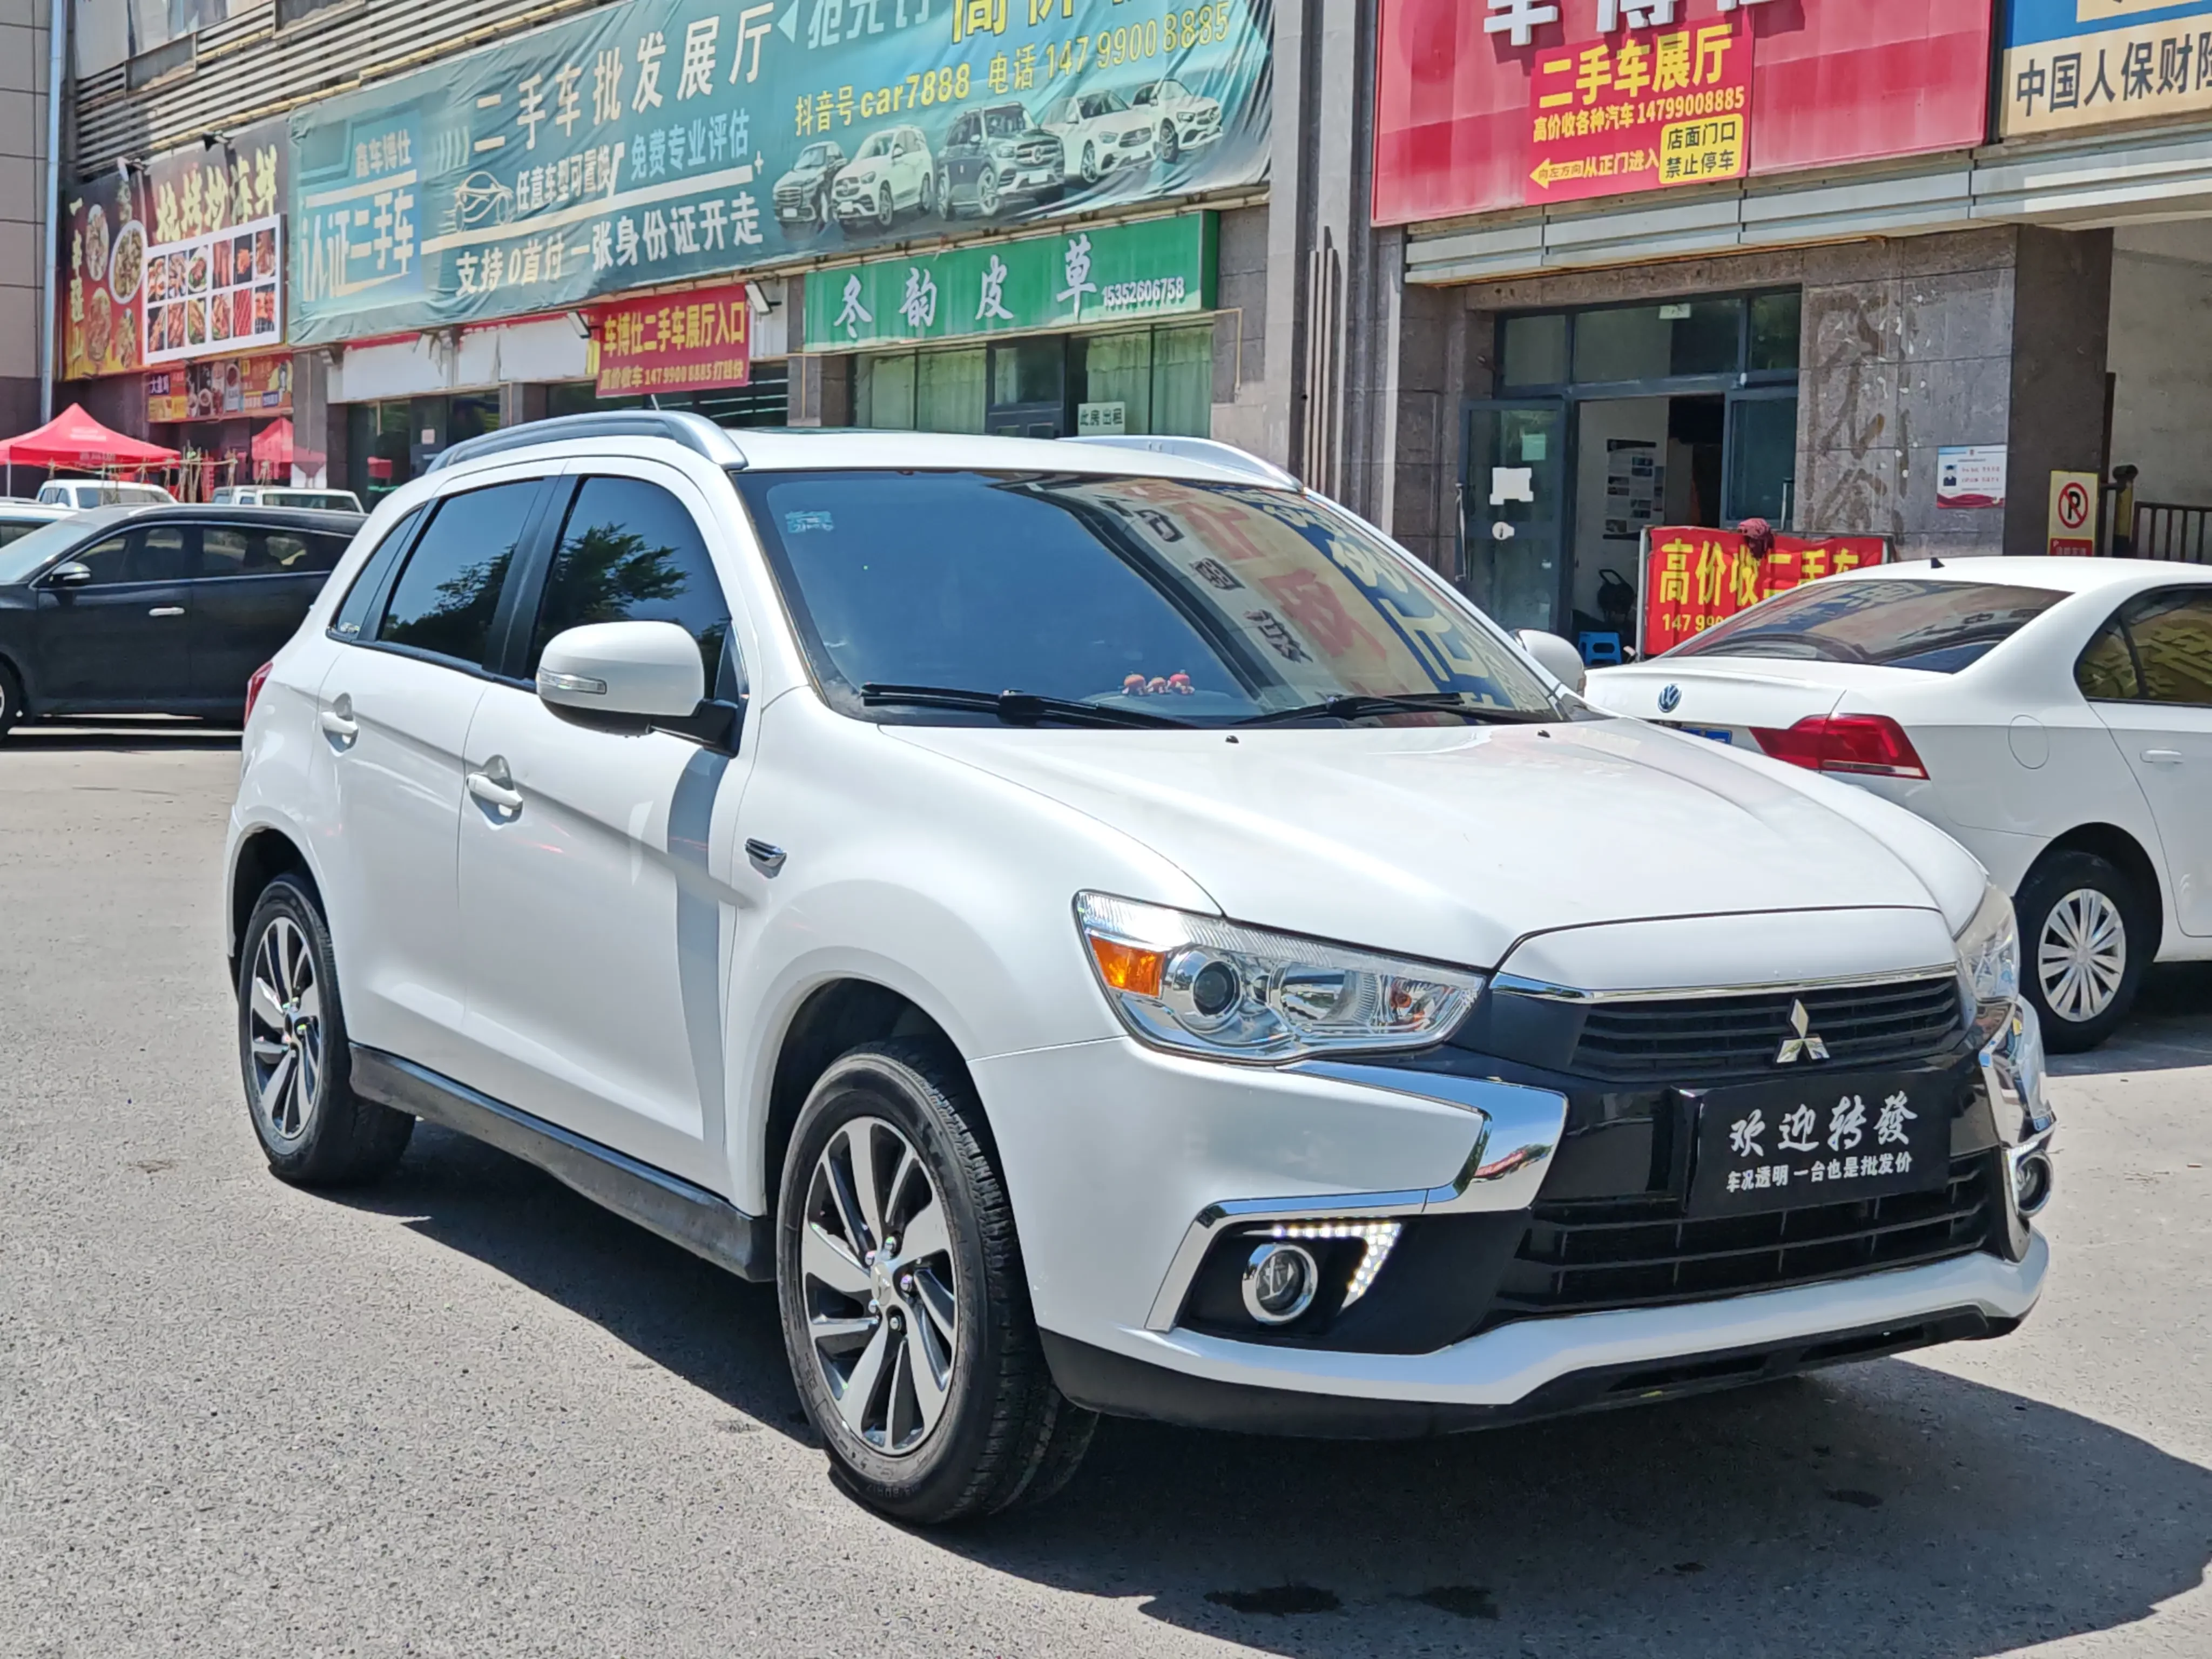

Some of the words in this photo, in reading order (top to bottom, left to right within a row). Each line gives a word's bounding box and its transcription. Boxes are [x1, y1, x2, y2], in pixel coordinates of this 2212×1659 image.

[988, 44, 1036, 95] 电话
[1046, 36, 1089, 79] 147
[1097, 19, 1157, 69] 9900
[1163, 2, 1229, 53] 8885
[1539, 24, 1732, 108] 二手车展厅
[474, 3, 774, 152] 二手车批发展厅
[1533, 103, 1634, 143] 高价收各种汽车
[1637, 86, 1745, 124] 14799008885
[1667, 120, 1736, 150] 店面门口
[630, 109, 750, 181] 免费专业评估
[1538, 164, 1582, 180] 向左方向
[1583, 147, 1660, 179] 从正门进入
[1665, 149, 1735, 179] 禁止停车
[301, 189, 414, 301] 认证二手车
[834, 234, 1097, 339] 冬韵皮草
[1102, 276, 1185, 307] 15352606758
[603, 301, 745, 357] 车博仕二手车展厅入口
[1662, 613, 1690, 631] 147
[1727, 1164, 1789, 1193] 车况透明
[1793, 1151, 1912, 1183] 一台也是批发价
